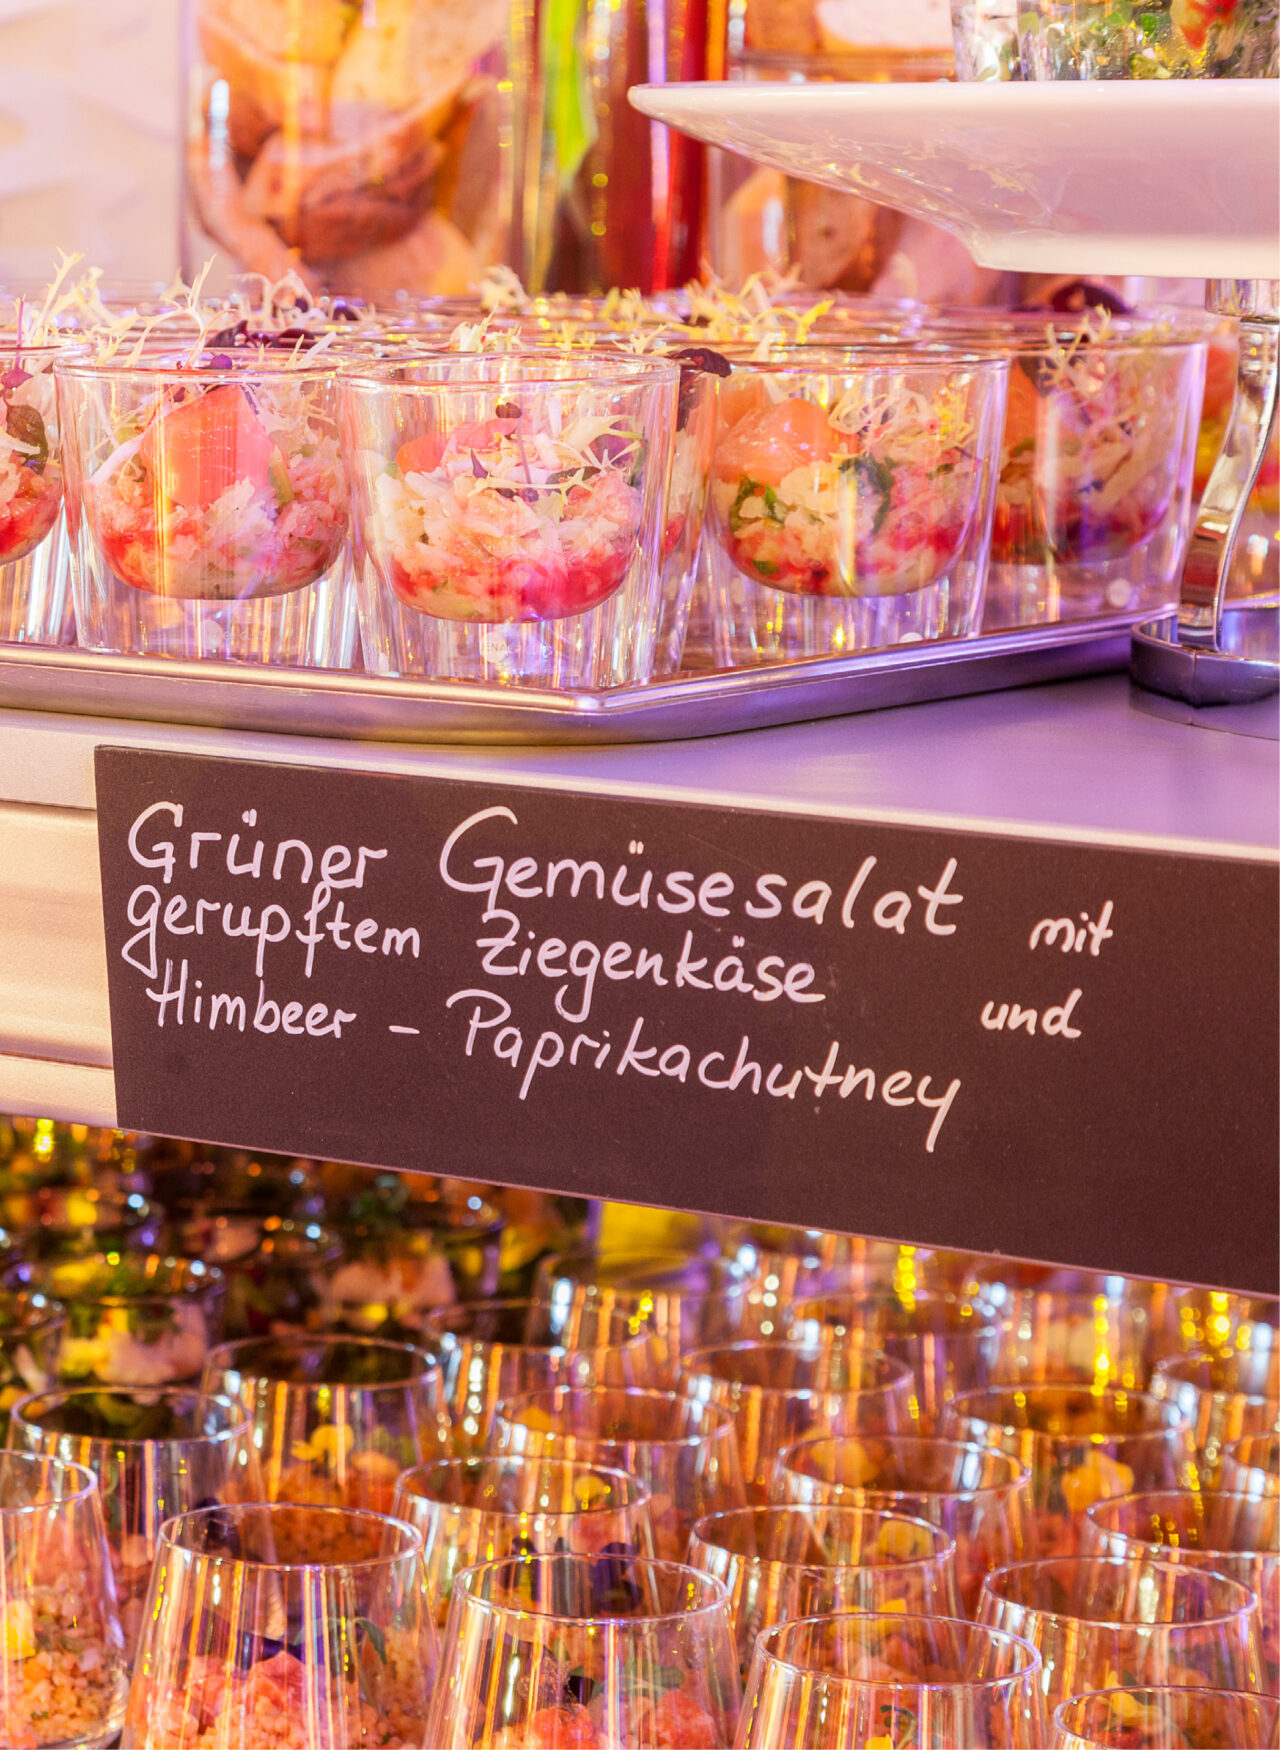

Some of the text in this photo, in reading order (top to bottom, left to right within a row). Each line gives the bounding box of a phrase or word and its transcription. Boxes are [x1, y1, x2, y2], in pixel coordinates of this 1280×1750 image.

[127, 800, 1114, 957] Grüner Gemüsesalat mit
[121, 881, 1083, 1039] gerupftem Ziegenkäse und
[145, 958, 357, 1039] Himbeer
[445, 988, 961, 1153] Paprikachutney
